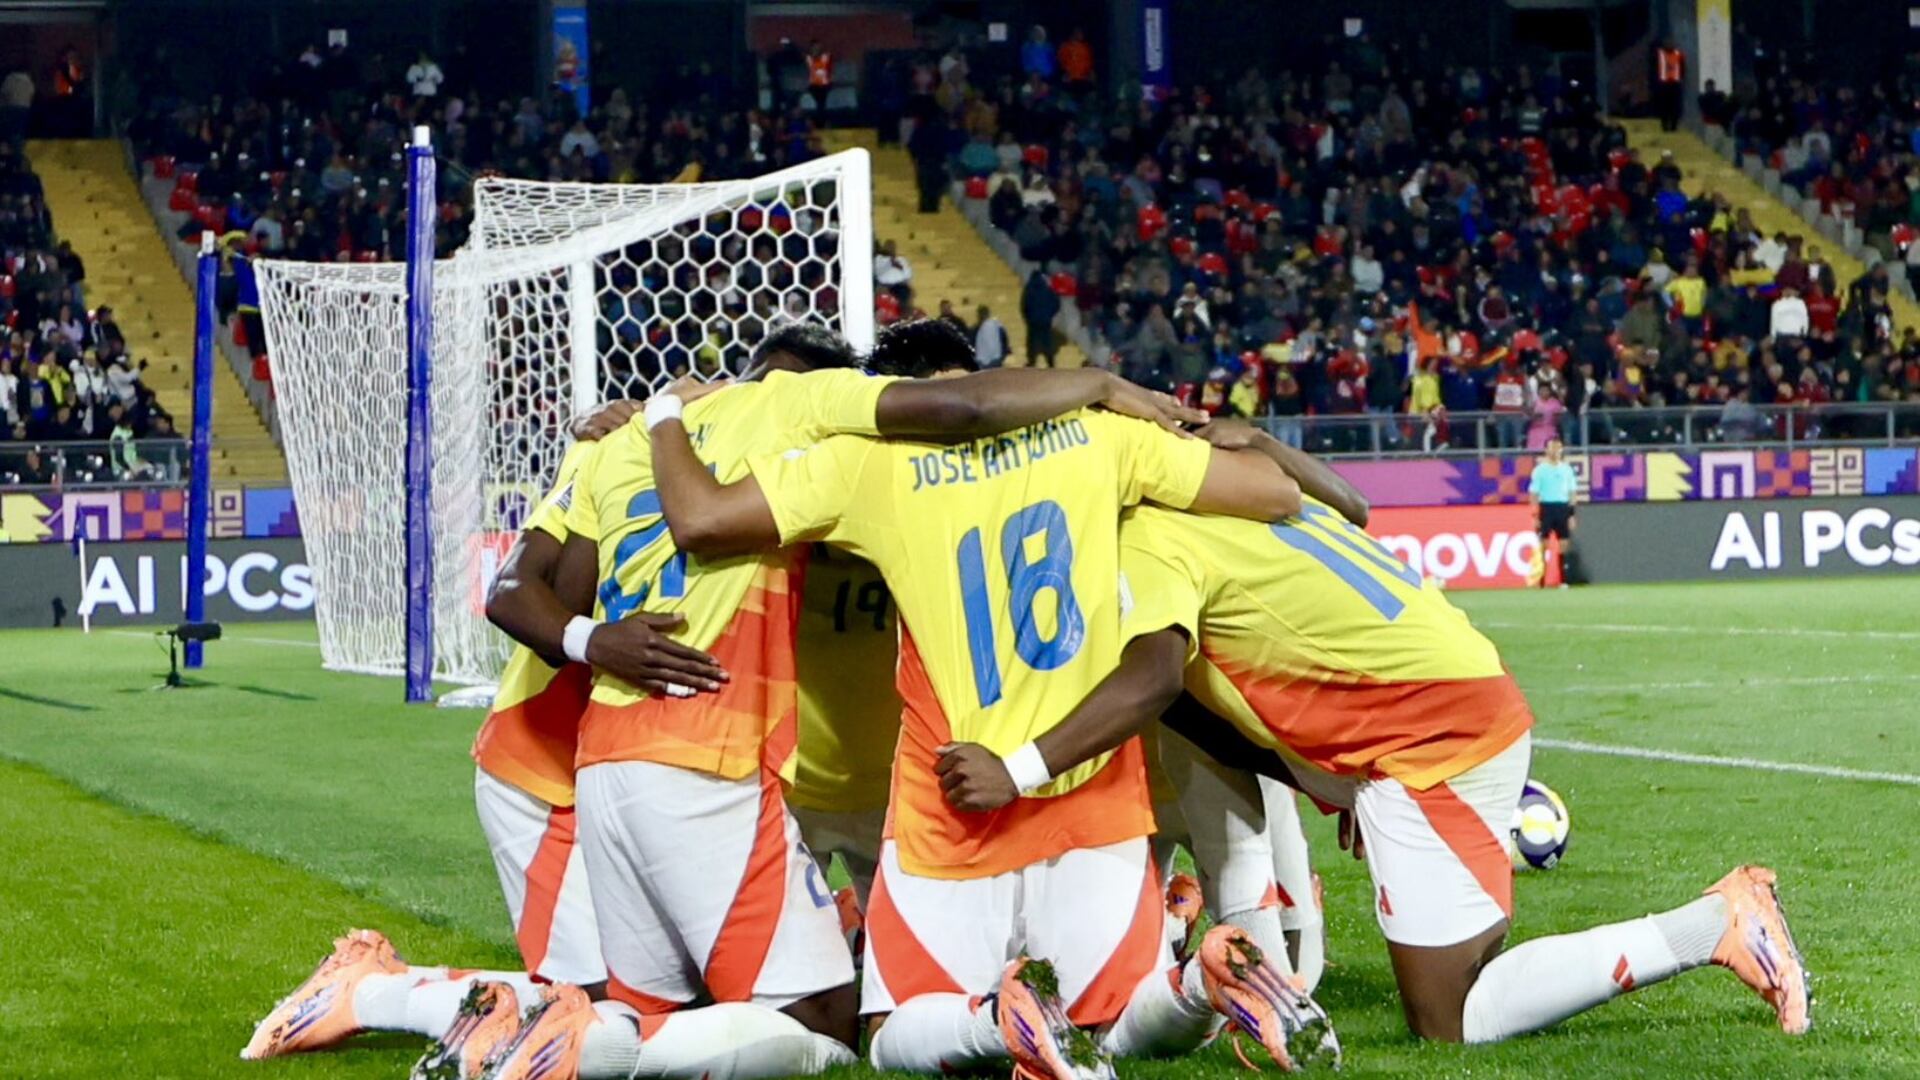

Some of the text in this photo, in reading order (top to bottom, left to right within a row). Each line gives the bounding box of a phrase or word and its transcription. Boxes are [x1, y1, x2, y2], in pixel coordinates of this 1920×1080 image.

[1710, 508, 1920, 570] AI PCs
[77, 556, 155, 614] AI
[834, 580, 888, 632] 19
[957, 499, 1085, 710] 18
